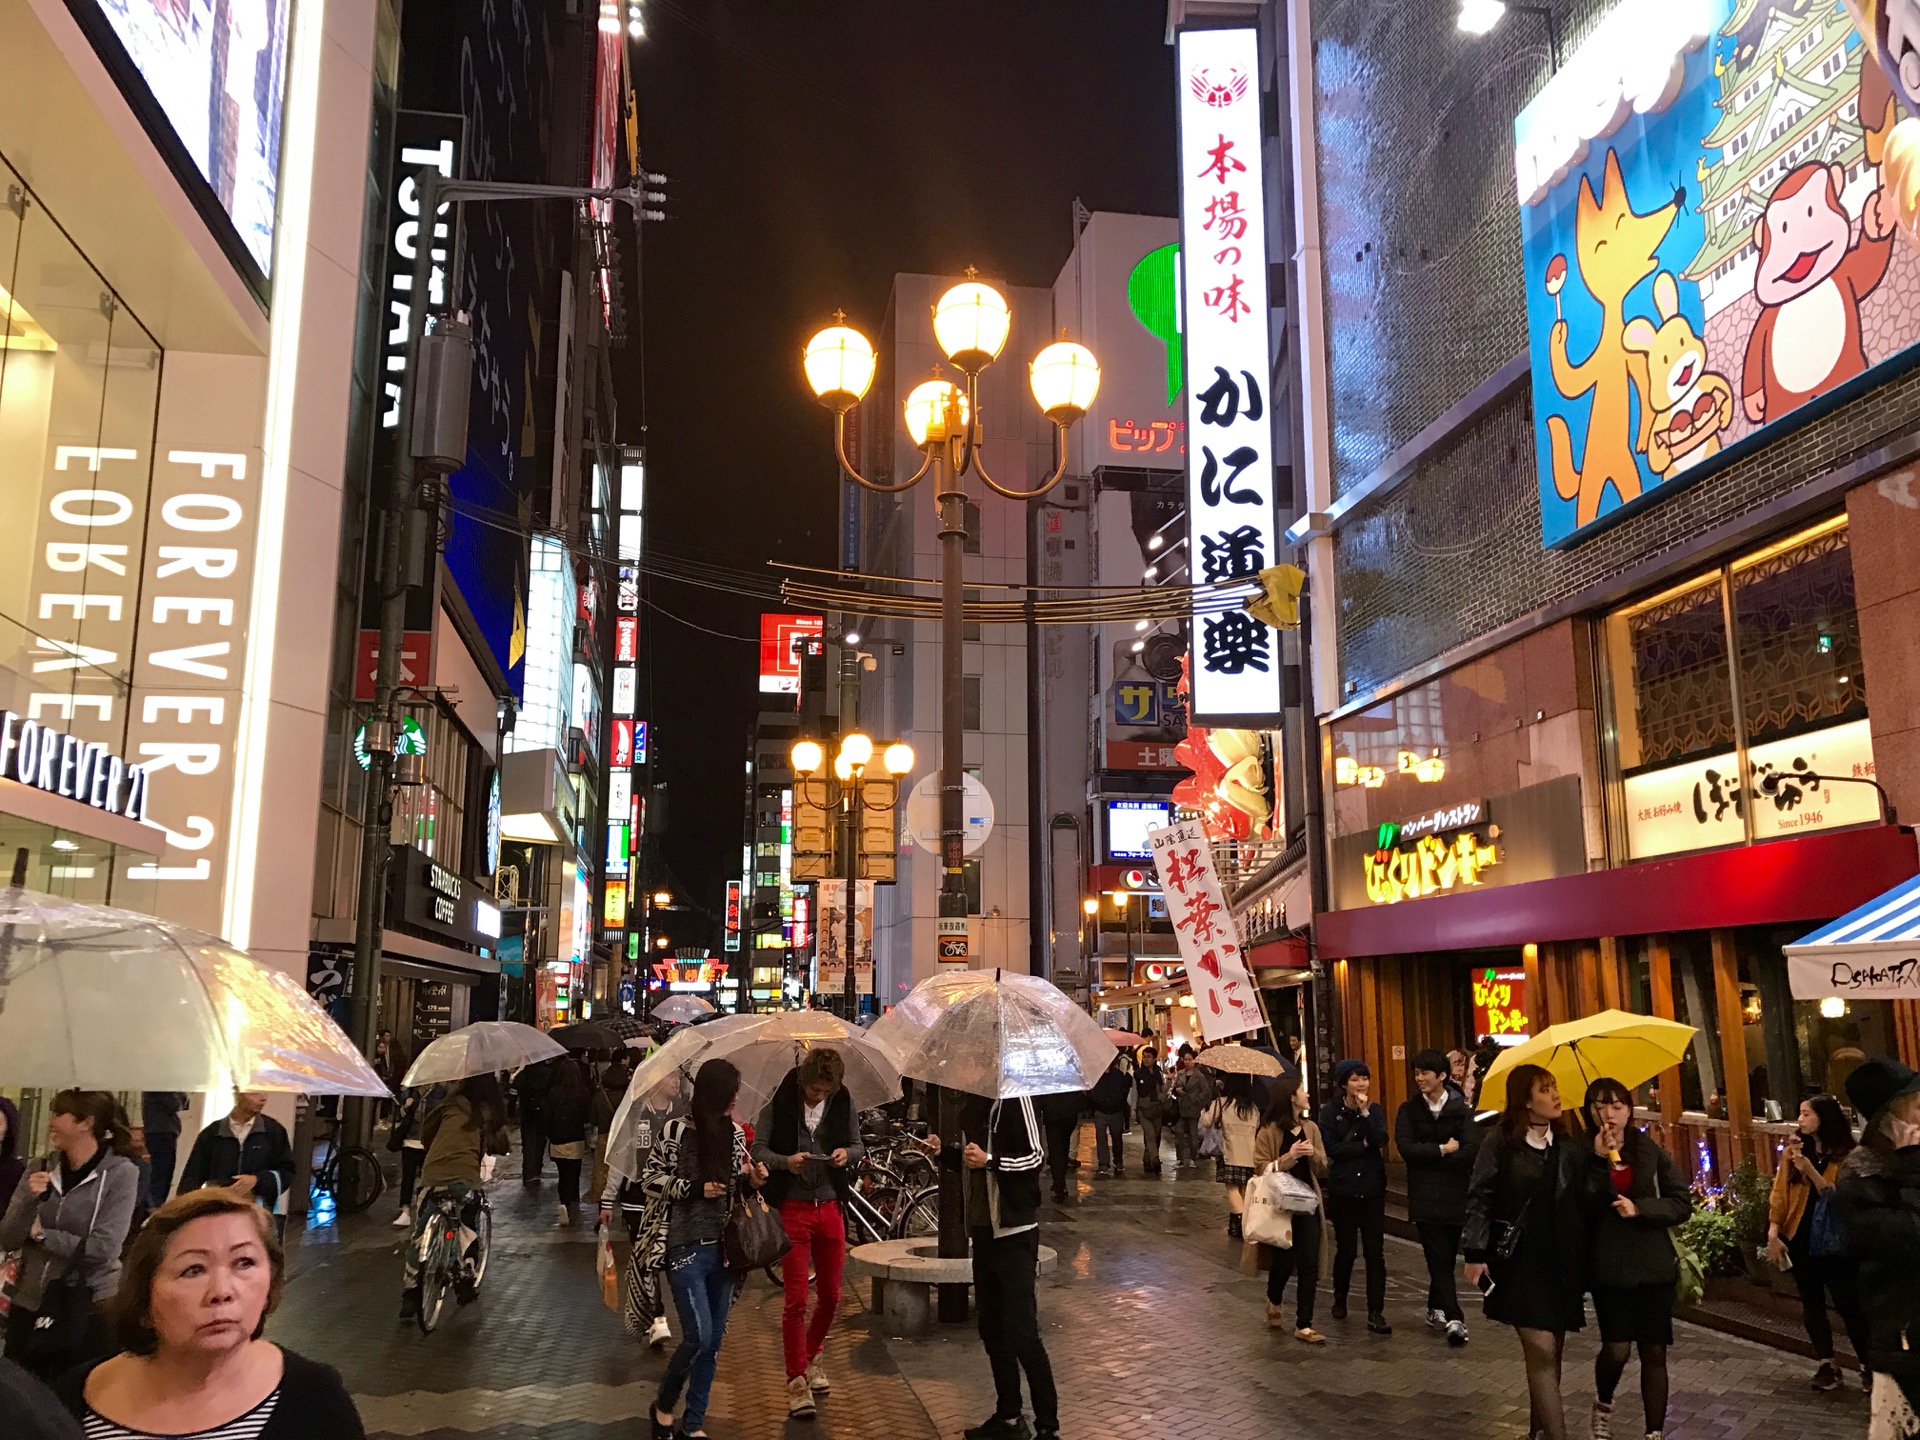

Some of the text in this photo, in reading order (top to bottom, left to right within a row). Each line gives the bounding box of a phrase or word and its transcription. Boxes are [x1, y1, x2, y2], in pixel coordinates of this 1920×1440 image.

[1197, 133, 1251, 323] 本場の味
[1110, 419, 1184, 453] ピップ
[127, 450, 246, 880] FOREVER 21
[0, 710, 148, 821] FOREVER 21
[1778, 810, 1823, 829] Since 1946
[430, 864, 462, 900] STARBUCKS
[1364, 833, 1496, 904] びっくりドンキー
[434, 896, 454, 924] COFFEE
[1165, 848, 1246, 1016] 松葉かに
[1473, 983, 1511, 1009] びっくり
[1487, 1008, 1529, 1034] ドンキー
